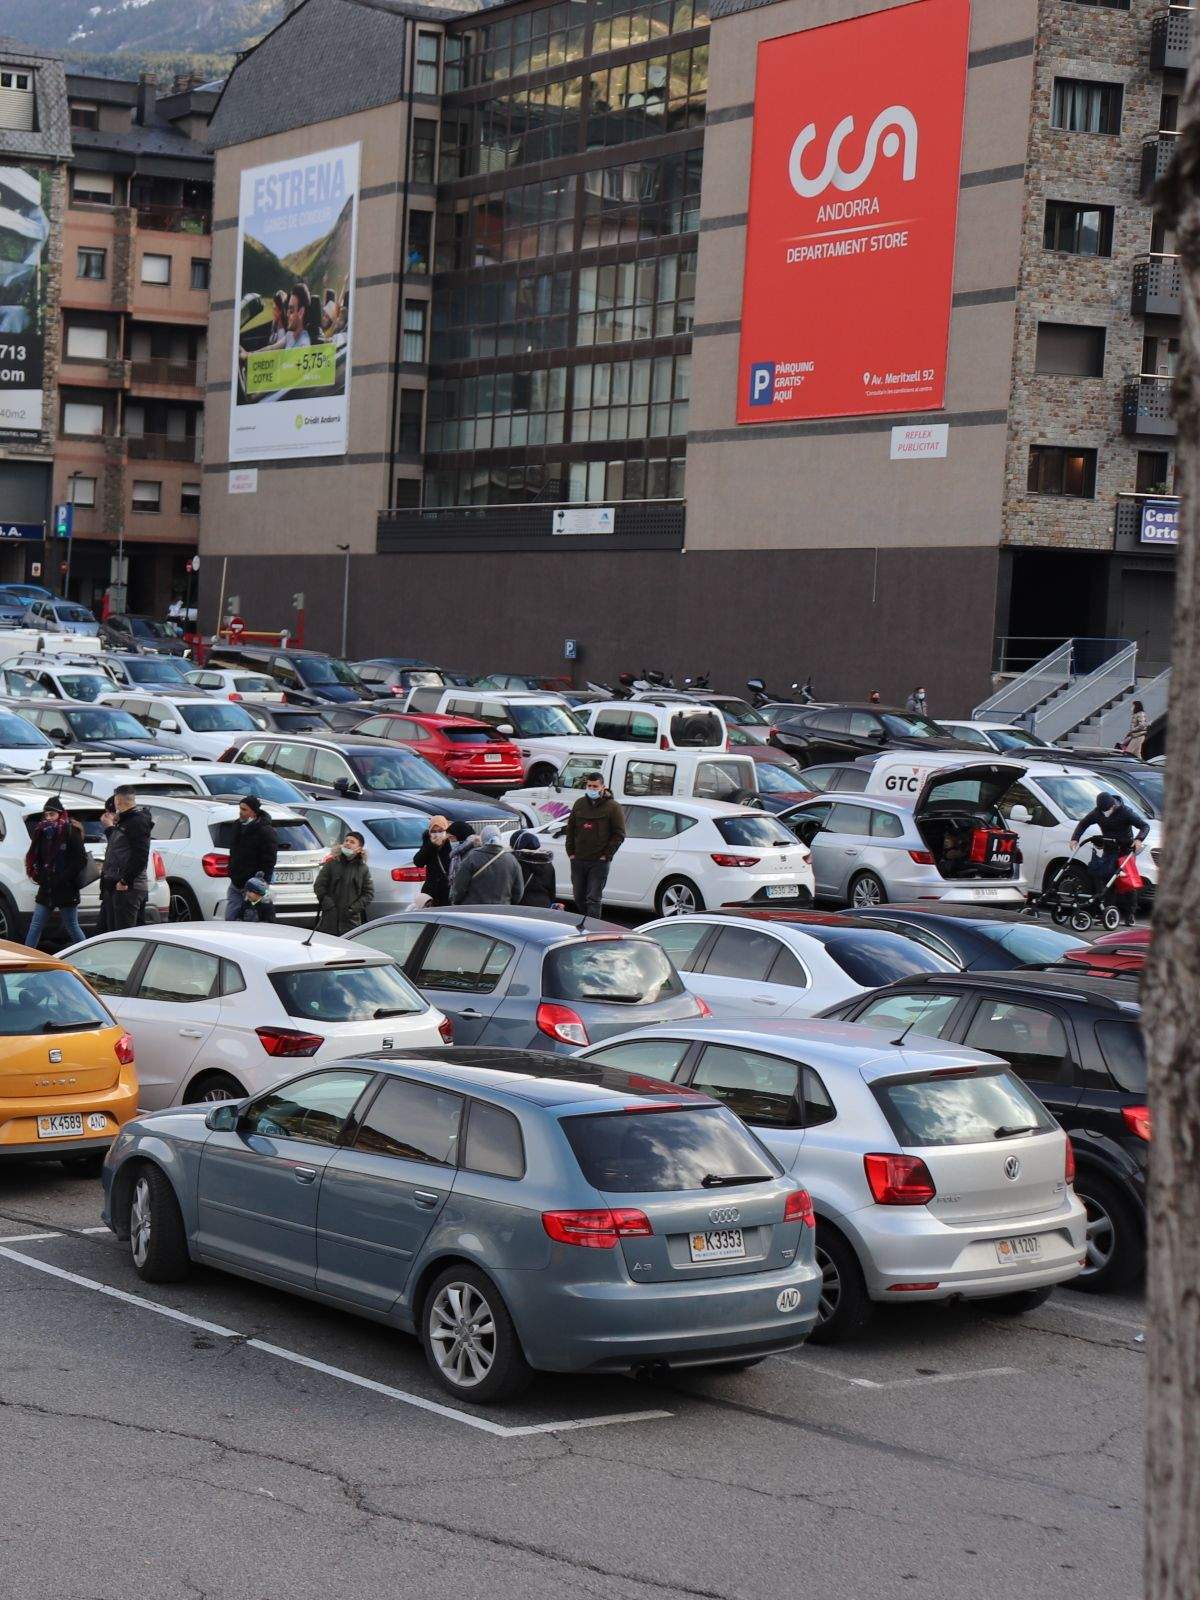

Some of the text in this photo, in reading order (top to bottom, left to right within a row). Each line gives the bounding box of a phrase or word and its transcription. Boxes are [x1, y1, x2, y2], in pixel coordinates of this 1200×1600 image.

[254, 158, 346, 216] ESTRENA
[816, 196, 880, 223] ANDORRA
[786, 231, 909, 263] DEPARTAMENT STORE
[0, 344, 27, 361] 713
[775, 361, 815, 375] PÀRQUING
[753, 369, 771, 400] P
[871, 369, 934, 386] Av. Meritxell 92
[773, 389, 793, 403] AQUÍ
[905, 431, 932, 440] REFLEX
[897, 442, 940, 452] PUBLICITAT
[885, 775, 919, 792] GTC
[990, 853, 1011, 863] AND
[275, 872, 294, 882] 2270
[90, 1114, 106, 1129] AND
[706, 1229, 742, 1251] K3353
[633, 1262, 652, 1272] A3
[779, 1290, 798, 1309] AND
